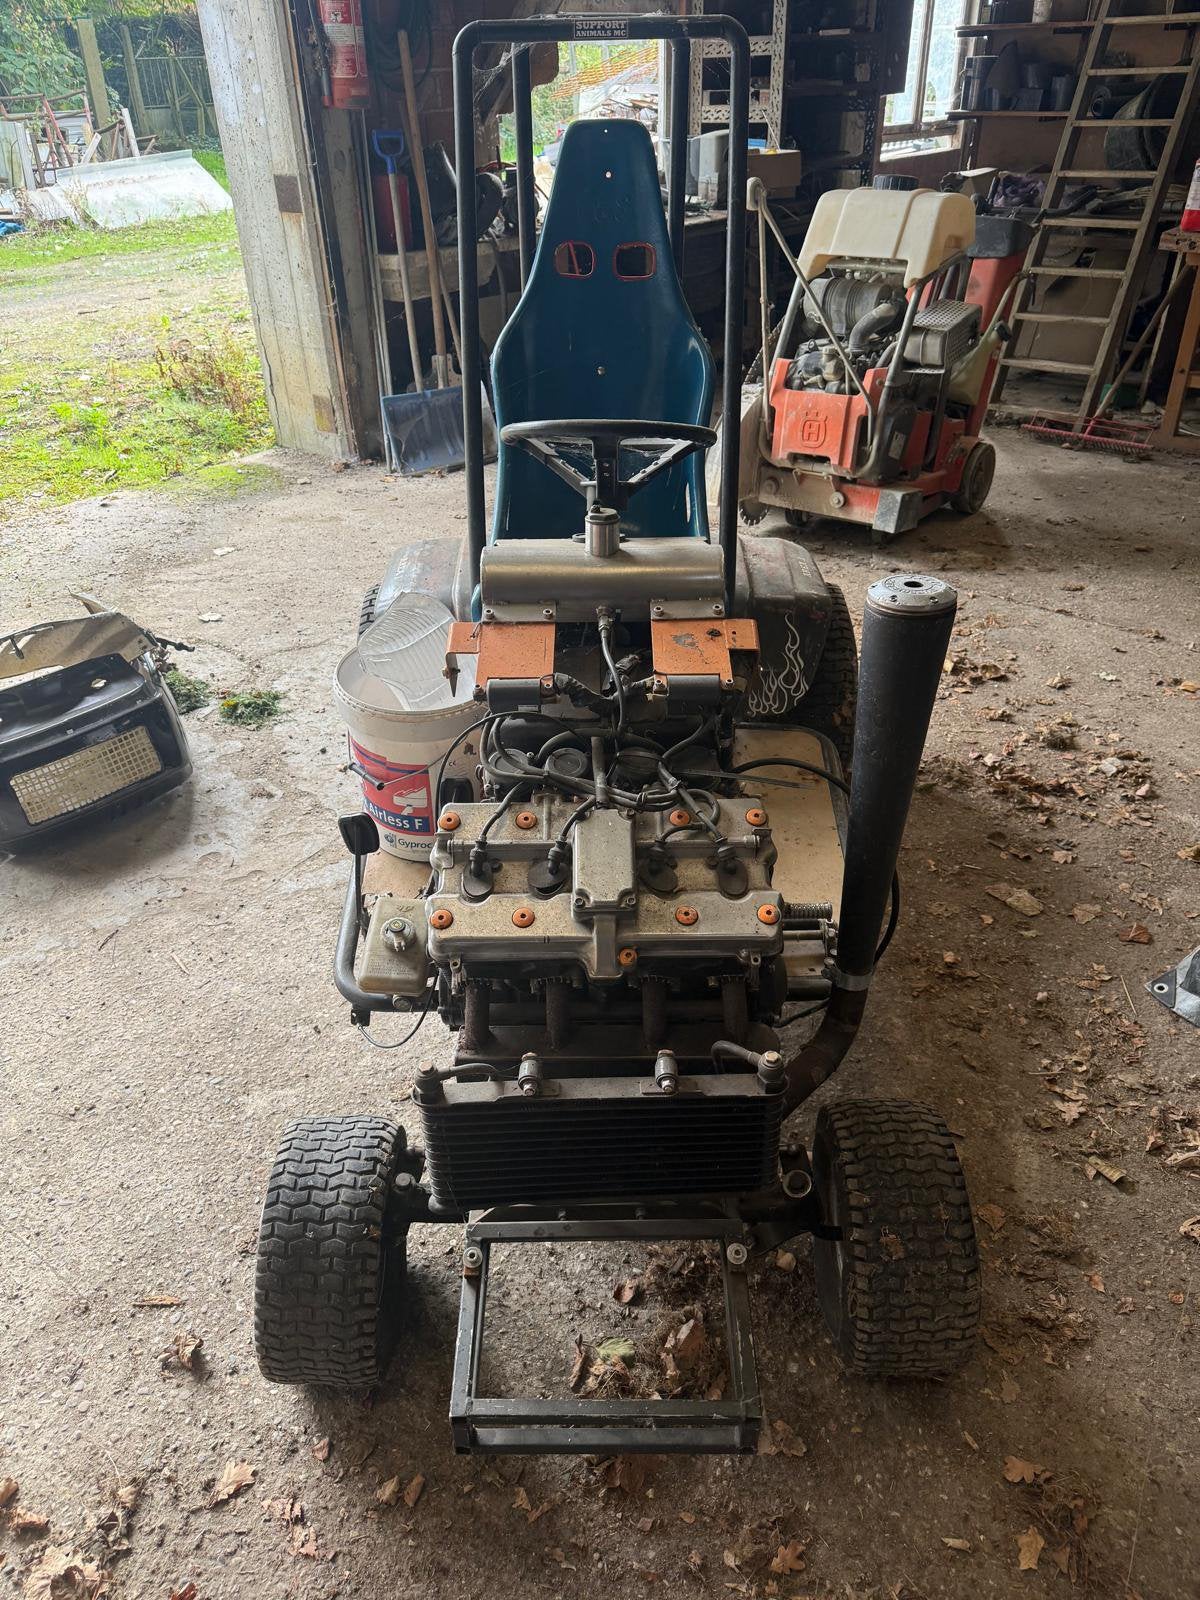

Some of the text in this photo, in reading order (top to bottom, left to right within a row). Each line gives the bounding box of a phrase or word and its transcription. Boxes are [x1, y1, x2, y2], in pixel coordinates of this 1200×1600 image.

[575, 20, 626, 29] SUPPORT
[369, 802, 409, 829] Airless
[414, 818, 423, 830] F
[398, 838, 433, 849] Gyproc
